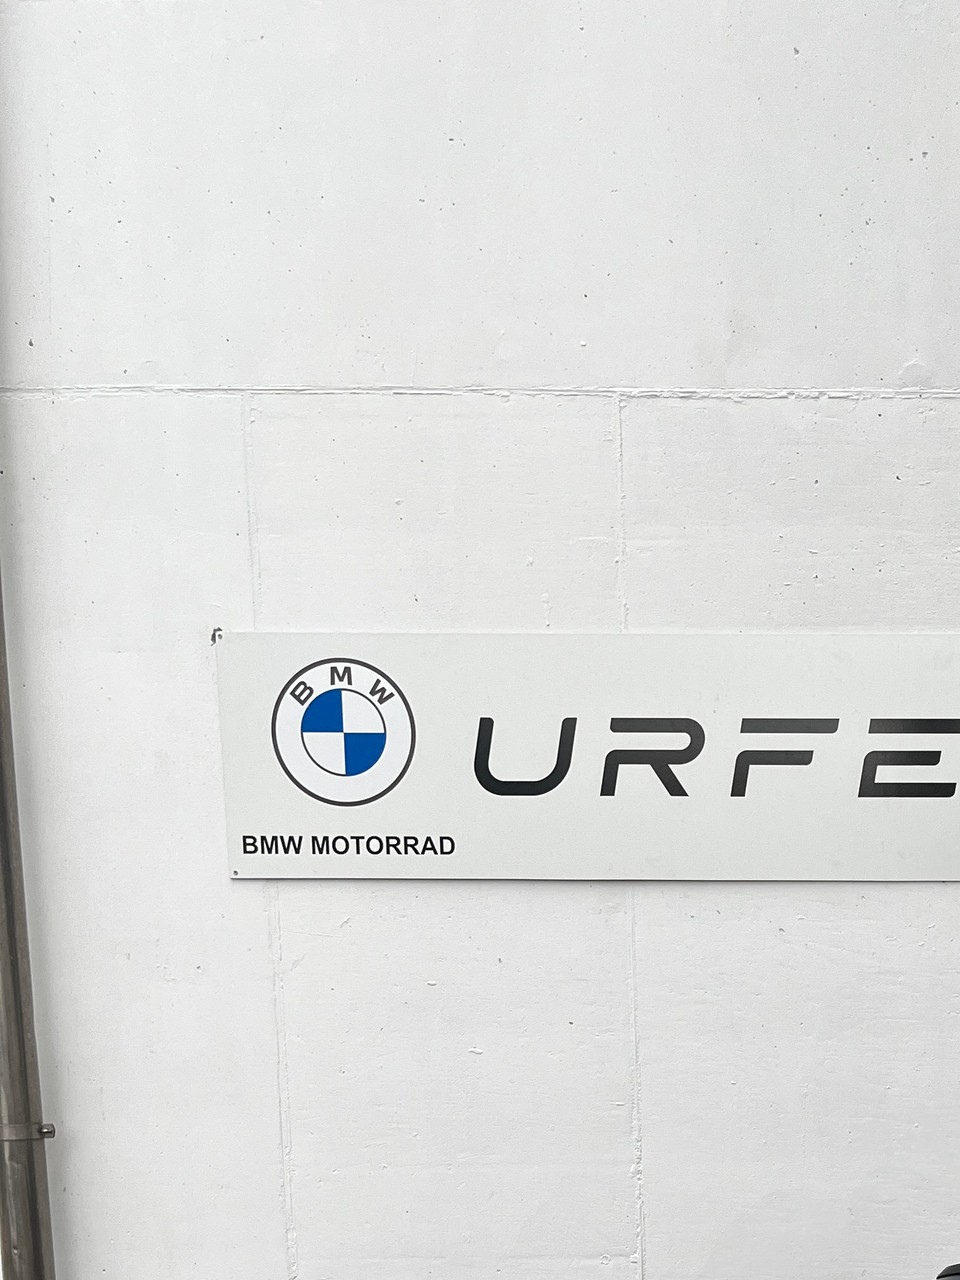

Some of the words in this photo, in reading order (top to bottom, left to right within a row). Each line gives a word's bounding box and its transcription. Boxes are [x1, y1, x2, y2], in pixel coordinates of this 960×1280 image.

[290, 666, 395, 706] BMW
[242, 835, 303, 855] BMW
[311, 835, 456, 855] MOTORRAD
